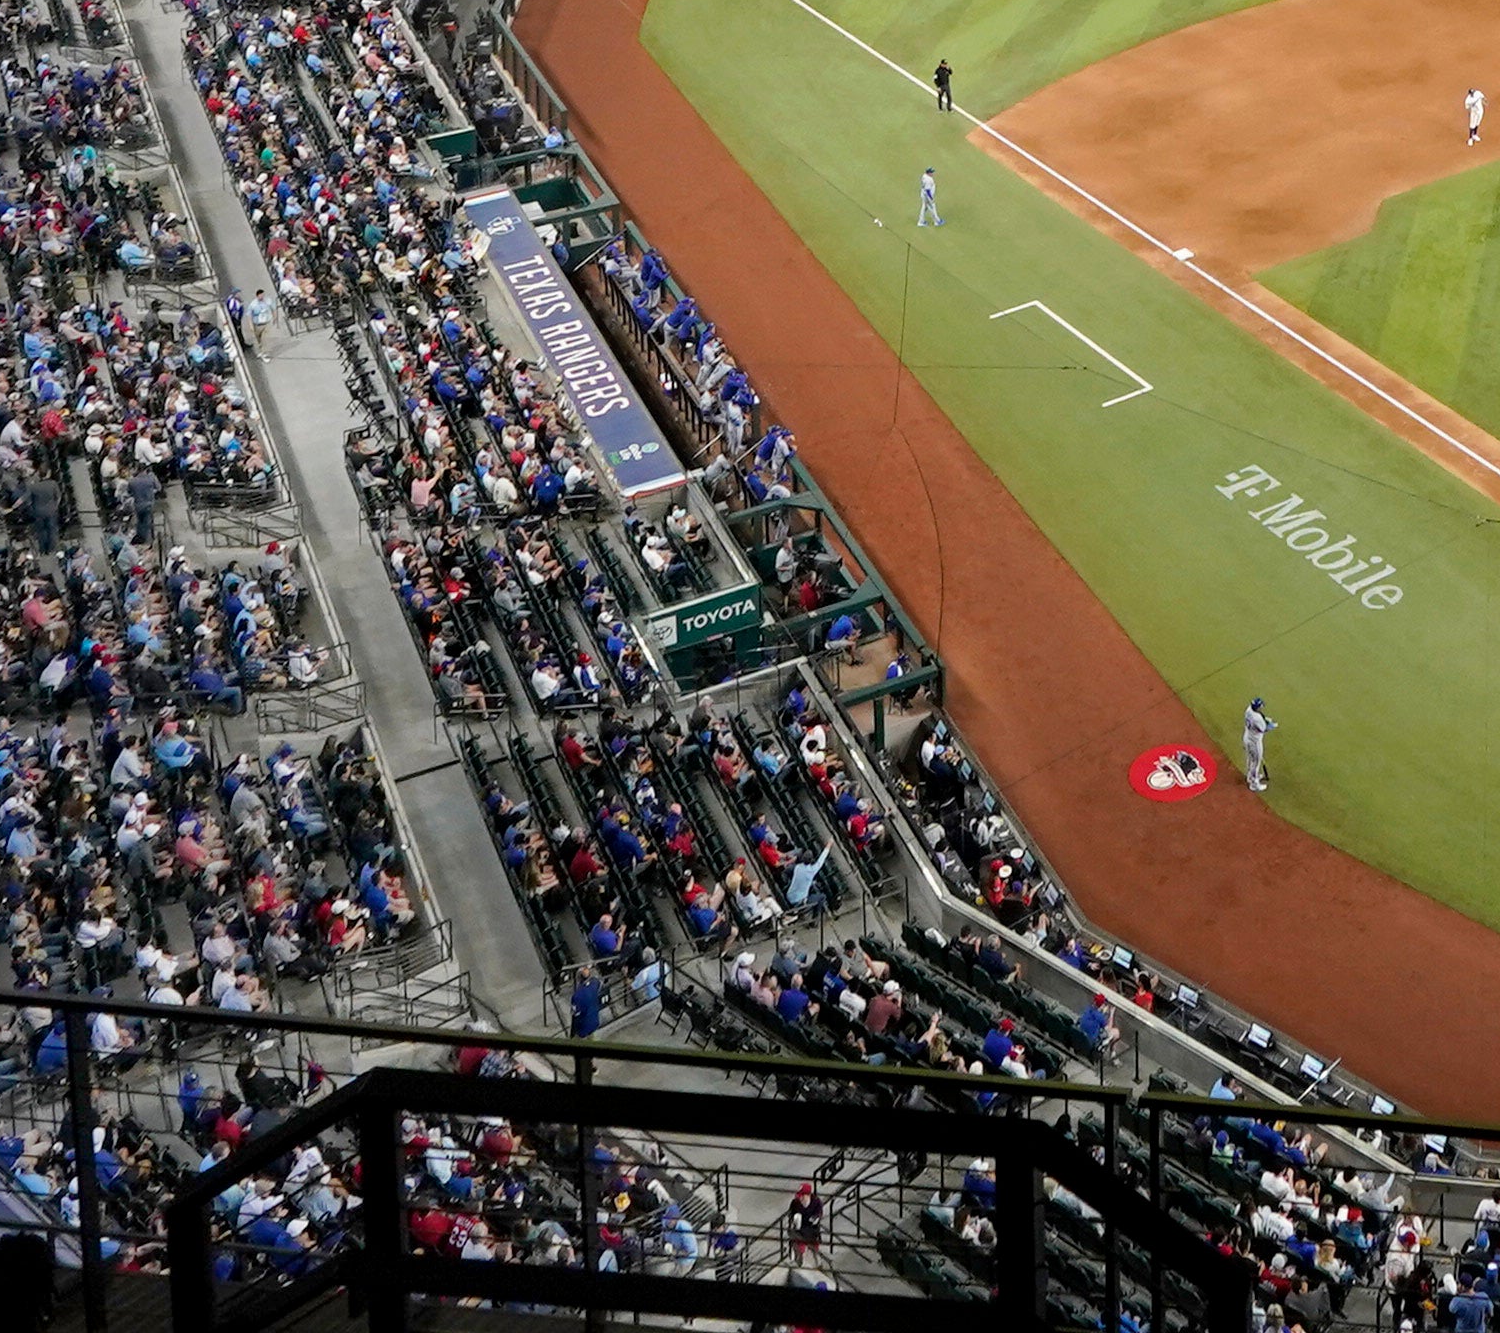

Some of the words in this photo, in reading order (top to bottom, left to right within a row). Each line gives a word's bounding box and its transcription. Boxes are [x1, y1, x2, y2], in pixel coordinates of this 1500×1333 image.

[503, 254, 571, 321] TEXAS
[539, 314, 631, 419] RANGERS
[681, 598, 757, 632] TOYOTA
